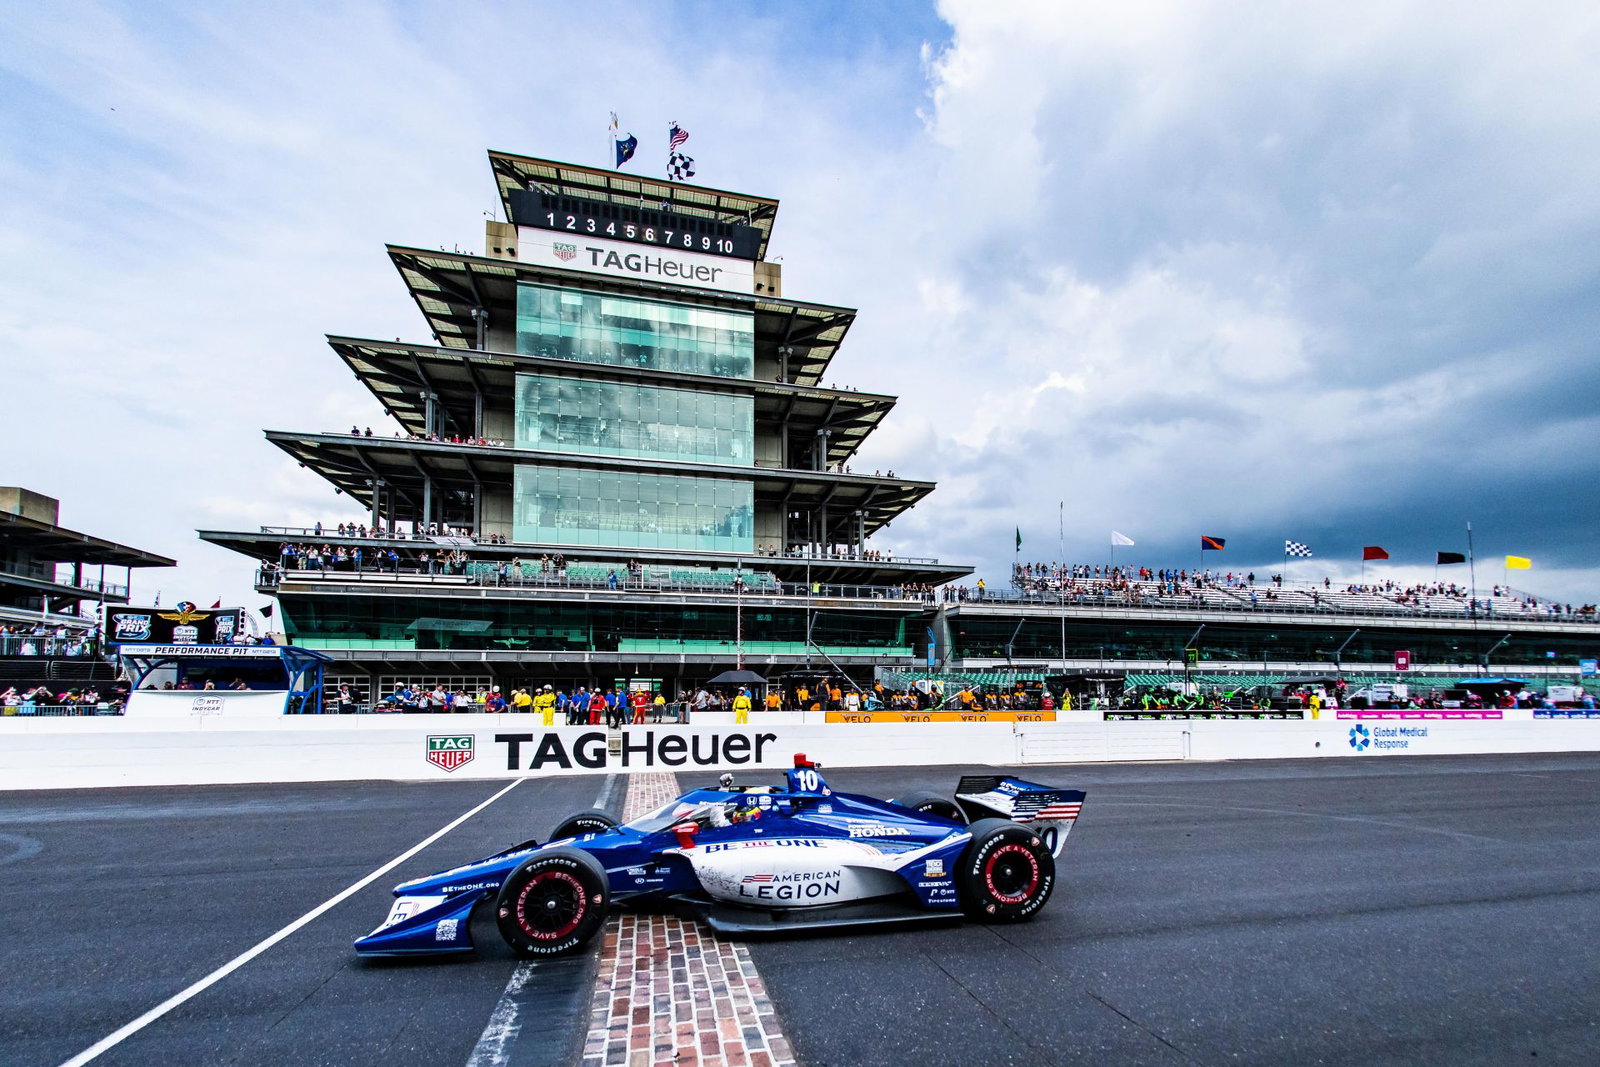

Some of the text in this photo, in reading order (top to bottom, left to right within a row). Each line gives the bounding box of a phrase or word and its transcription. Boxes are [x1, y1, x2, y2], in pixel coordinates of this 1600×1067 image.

[547, 213, 733, 253] 1 2 3 4 5 6 7 8 9 10
[116, 624, 148, 632] PRIX
[155, 647, 231, 655] PERFORMANCE
[1374, 727, 1428, 737] Global Medical
[431, 738, 470, 749] TAG
[1374, 738, 1408, 750] Response
[430, 751, 470, 768] HEUER
[797, 770, 818, 791] 10
[849, 827, 911, 838] HONDA
[705, 844, 737, 854] BE
[776, 840, 827, 848] ONE
[973, 834, 1004, 875] Firestone
[526, 858, 577, 872] Firestone
[993, 845, 1011, 859] SAVE
[1021, 847, 1038, 881] VETERAN
[773, 870, 841, 883] AMERICAN
[740, 880, 840, 900] LEGION
[1021, 876, 1051, 915] Firestone
[517, 879, 537, 924] VETERAN
[532, 931, 557, 939] SAVE
[527, 937, 579, 953] Firestone
